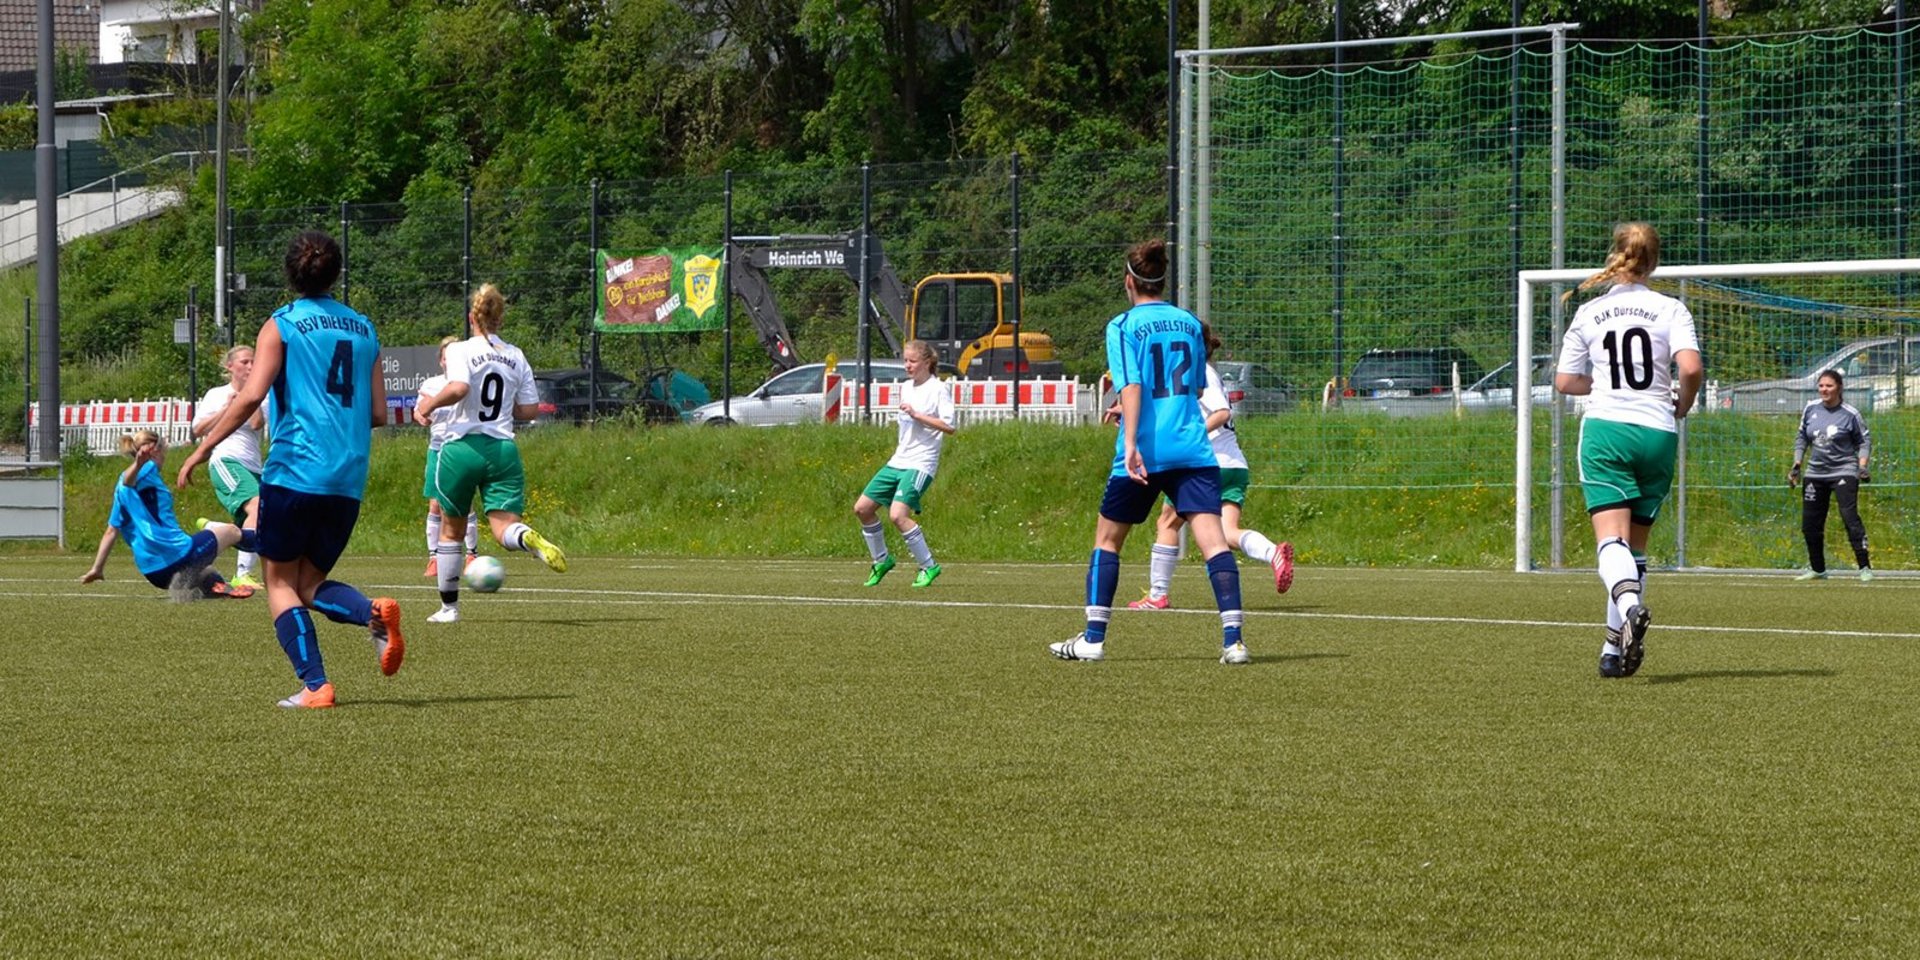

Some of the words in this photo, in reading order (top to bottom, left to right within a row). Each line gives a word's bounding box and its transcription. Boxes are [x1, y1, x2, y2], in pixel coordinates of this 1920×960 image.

[769, 250, 821, 265] Heinrich
[655, 293, 681, 321] DANKE!
[1594, 309, 1612, 325] DJK
[295, 315, 320, 335] BSV
[321, 314, 369, 339] BIELSTEIN
[1133, 322, 1153, 341] BSV
[1153, 320, 1196, 338] BIELSTEIN
[382, 356, 400, 373] die
[1149, 341, 1192, 399] 12
[1603, 327, 1654, 390] 10
[326, 340, 354, 408] 4
[478, 372, 505, 423] 9
